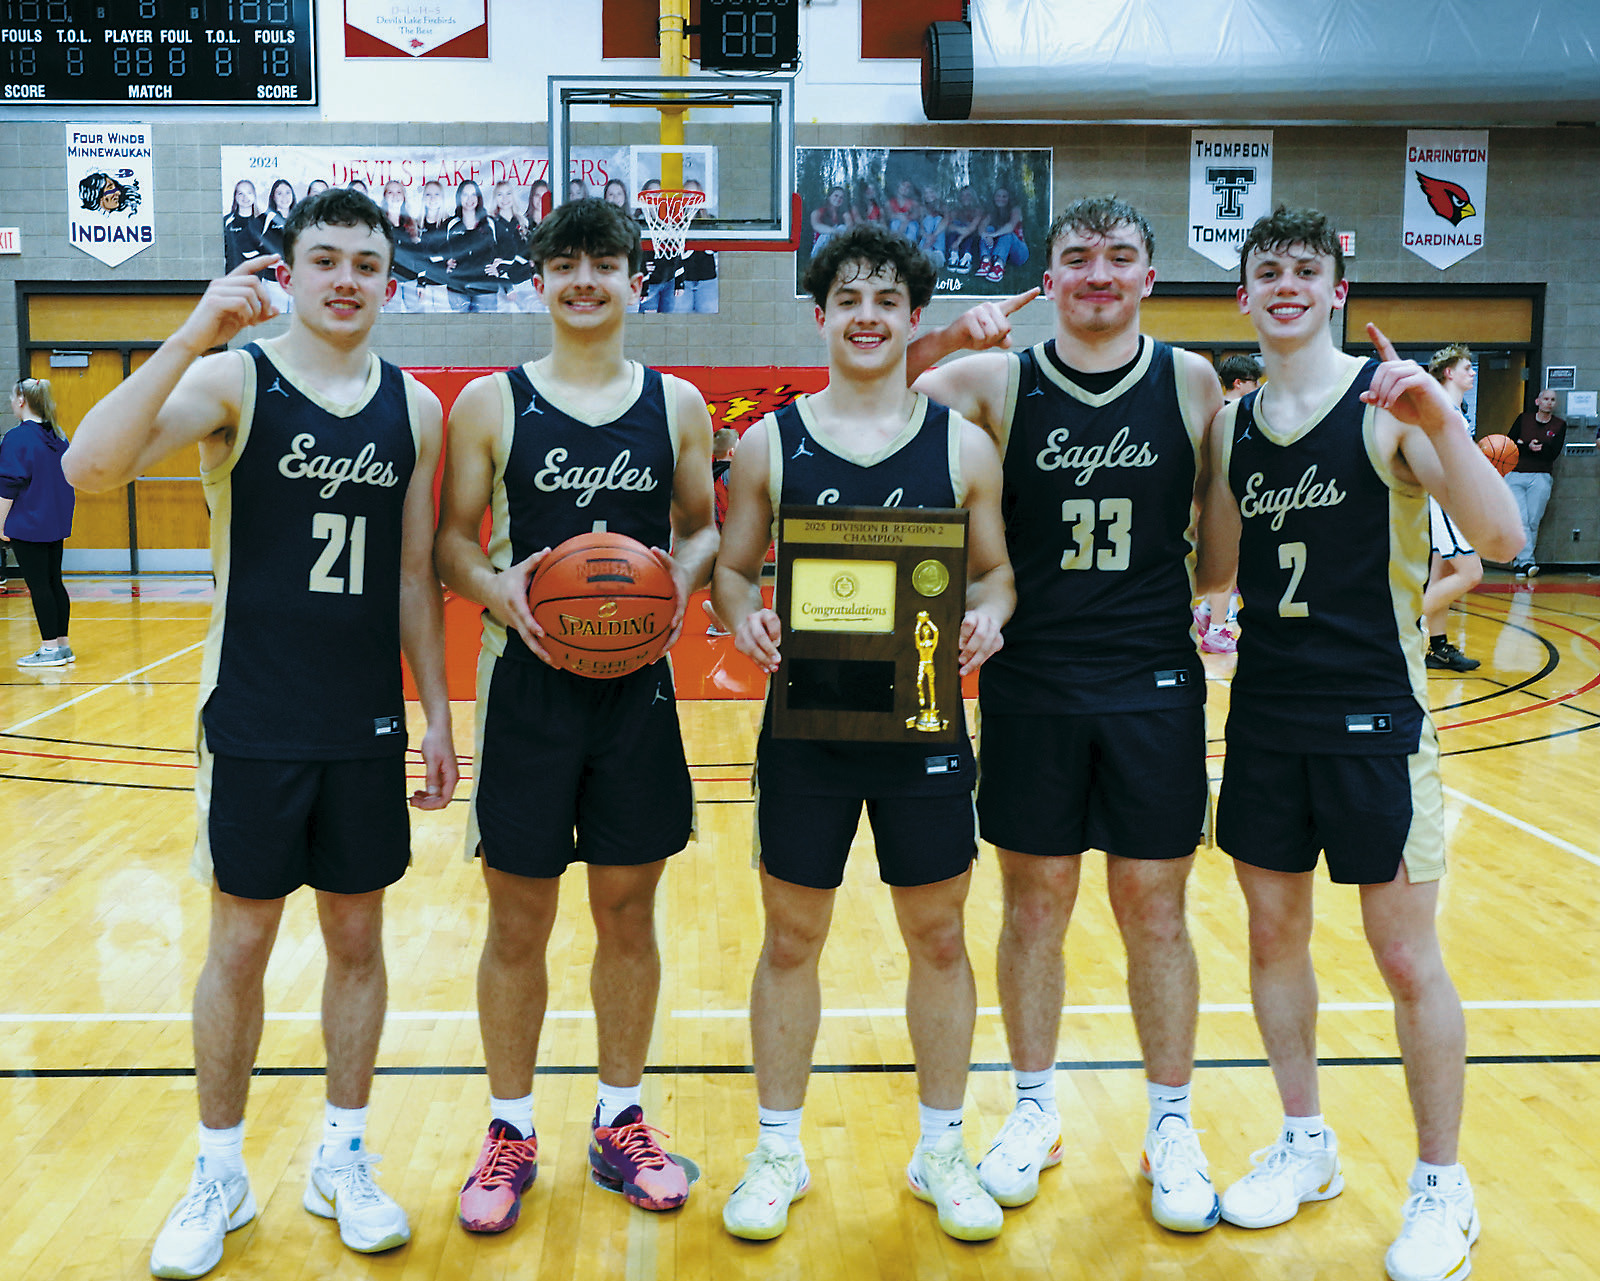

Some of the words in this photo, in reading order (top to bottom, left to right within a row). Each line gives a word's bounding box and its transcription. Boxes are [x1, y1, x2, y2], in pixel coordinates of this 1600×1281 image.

[376, 16, 401, 24] Devils
[404, 16, 421, 24] Lake
[424, 16, 456, 24] Firebirds
[1, 29, 42, 43] FOULS
[57, 29, 91, 43] T.O.L.
[105, 29, 153, 43] PLAYER
[160, 29, 192, 43] FOUL
[205, 30, 240, 43] T.O.L.
[255, 30, 295, 43] FOULS
[400, 26, 414, 34] The
[417, 26, 432, 34] Best
[4, 84, 46, 98] SCORE
[128, 85, 172, 98] MATCH
[257, 85, 298, 98] SCORE
[73, 132, 103, 144] FOUR
[108, 132, 144, 144] WINDS
[68, 146, 151, 158] MINNEWAUKAN
[1195, 139, 1269, 157] THOMPSON
[1408, 146, 1486, 163] CARRINGTON
[249, 156, 278, 168] 2024
[332, 159, 413, 187] DEVILS
[421, 159, 483, 187] LAKE
[491, 159, 609, 187] DAZZERS
[0, 232, 13, 248] XIT
[71, 222, 153, 243] INDIANS
[1193, 225, 1251, 242] TOMMI
[1404, 231, 1482, 246] CARDINALS
[1035, 425, 1159, 487] Eagles
[277, 432, 399, 500] Eagles
[533, 447, 658, 508] Eagles
[1240, 463, 1347, 532] Eagles
[804, 522, 826, 531] 2025
[831, 523, 878, 533] DIVISION
[881, 524, 889, 533] B
[893, 525, 935, 535] REGION
[937, 526, 944, 535] 2
[1060, 497, 1133, 571] 33
[843, 534, 904, 543] CHAMPION
[308, 512, 367, 595] 21
[1278, 541, 1310, 618] 2
[801, 602, 887, 617] Congratulations
[559, 612, 655, 636] SPALDING
